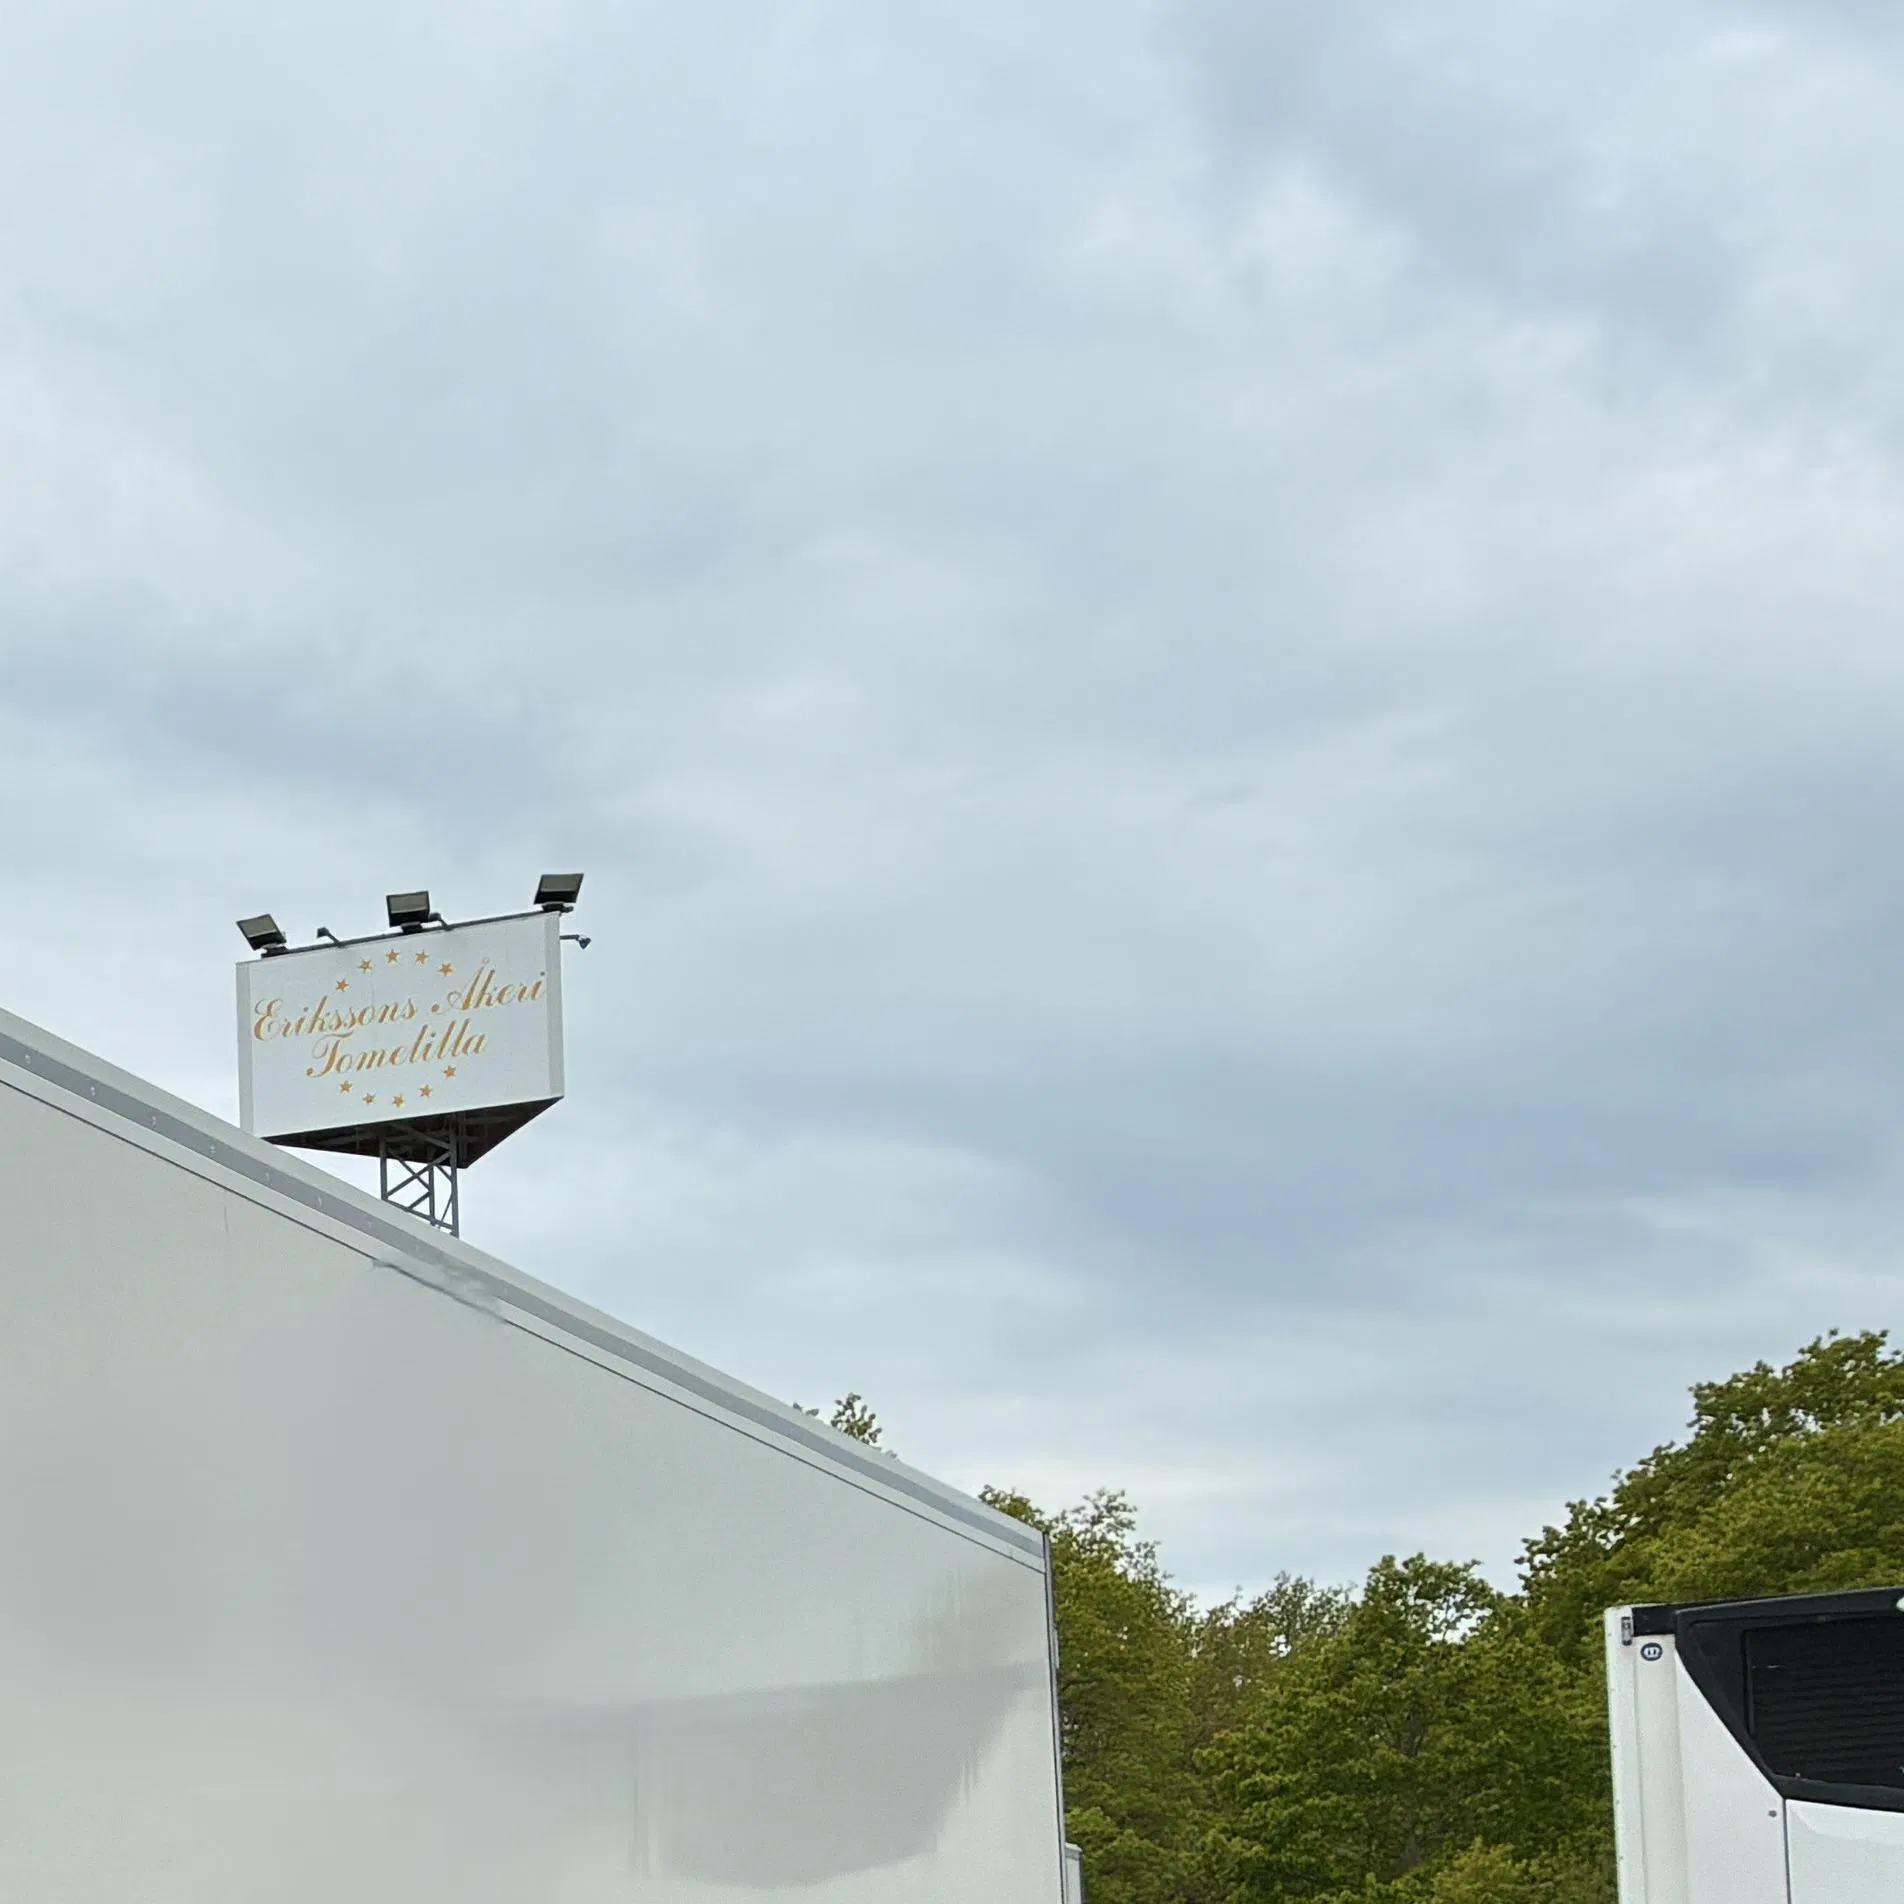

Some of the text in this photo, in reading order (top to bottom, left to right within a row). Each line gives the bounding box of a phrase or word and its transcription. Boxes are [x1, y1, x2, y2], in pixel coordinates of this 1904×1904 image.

[253, 957, 547, 1041] Erikssons Åkeri
[306, 1017, 489, 1078] Tomelilla
